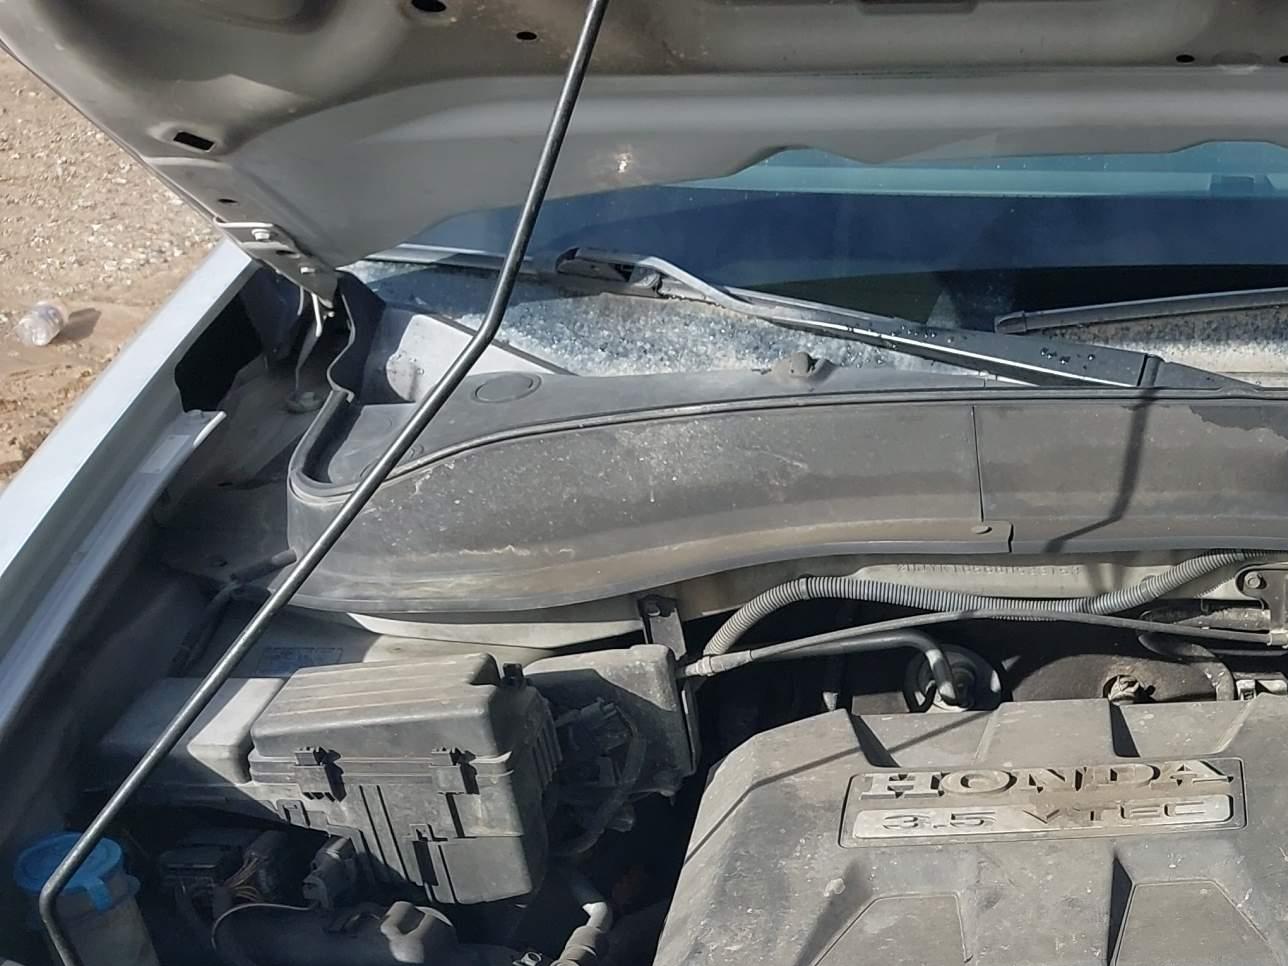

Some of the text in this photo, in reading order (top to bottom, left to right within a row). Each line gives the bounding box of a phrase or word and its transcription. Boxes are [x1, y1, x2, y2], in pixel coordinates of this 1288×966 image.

[859, 759, 1234, 800] HONDA
[882, 801, 1208, 830] 3.5 VTEC
